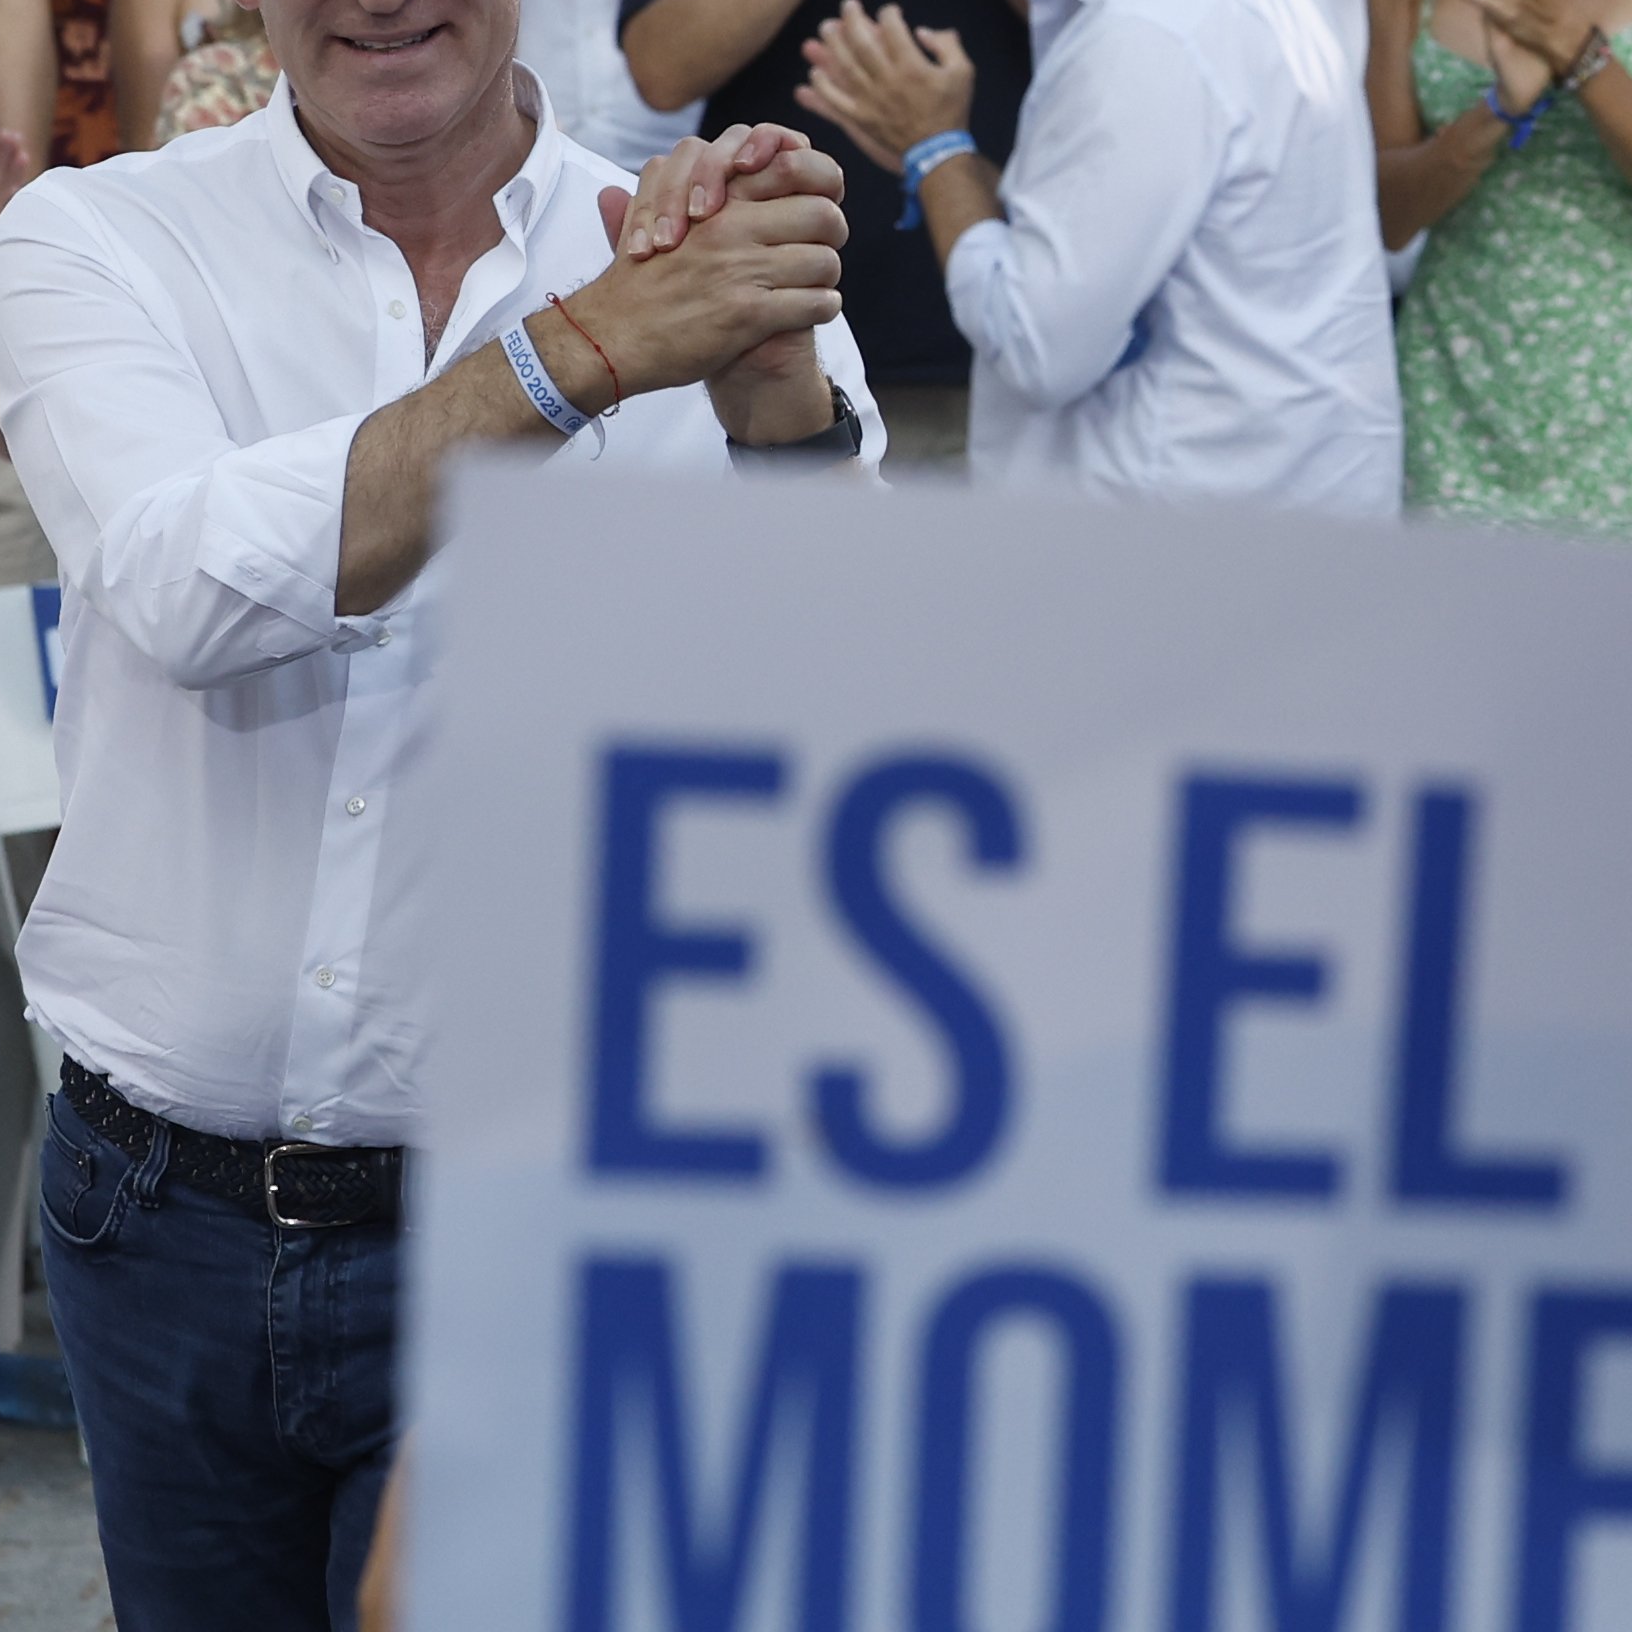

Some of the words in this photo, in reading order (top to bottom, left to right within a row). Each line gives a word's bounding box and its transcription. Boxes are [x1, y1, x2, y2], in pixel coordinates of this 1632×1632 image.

[505, 329, 534, 379] FEIJÓO
[526, 376, 563, 419] 2023
[583, 744, 1023, 1195] ES
[1155, 772, 1575, 1217] EL
